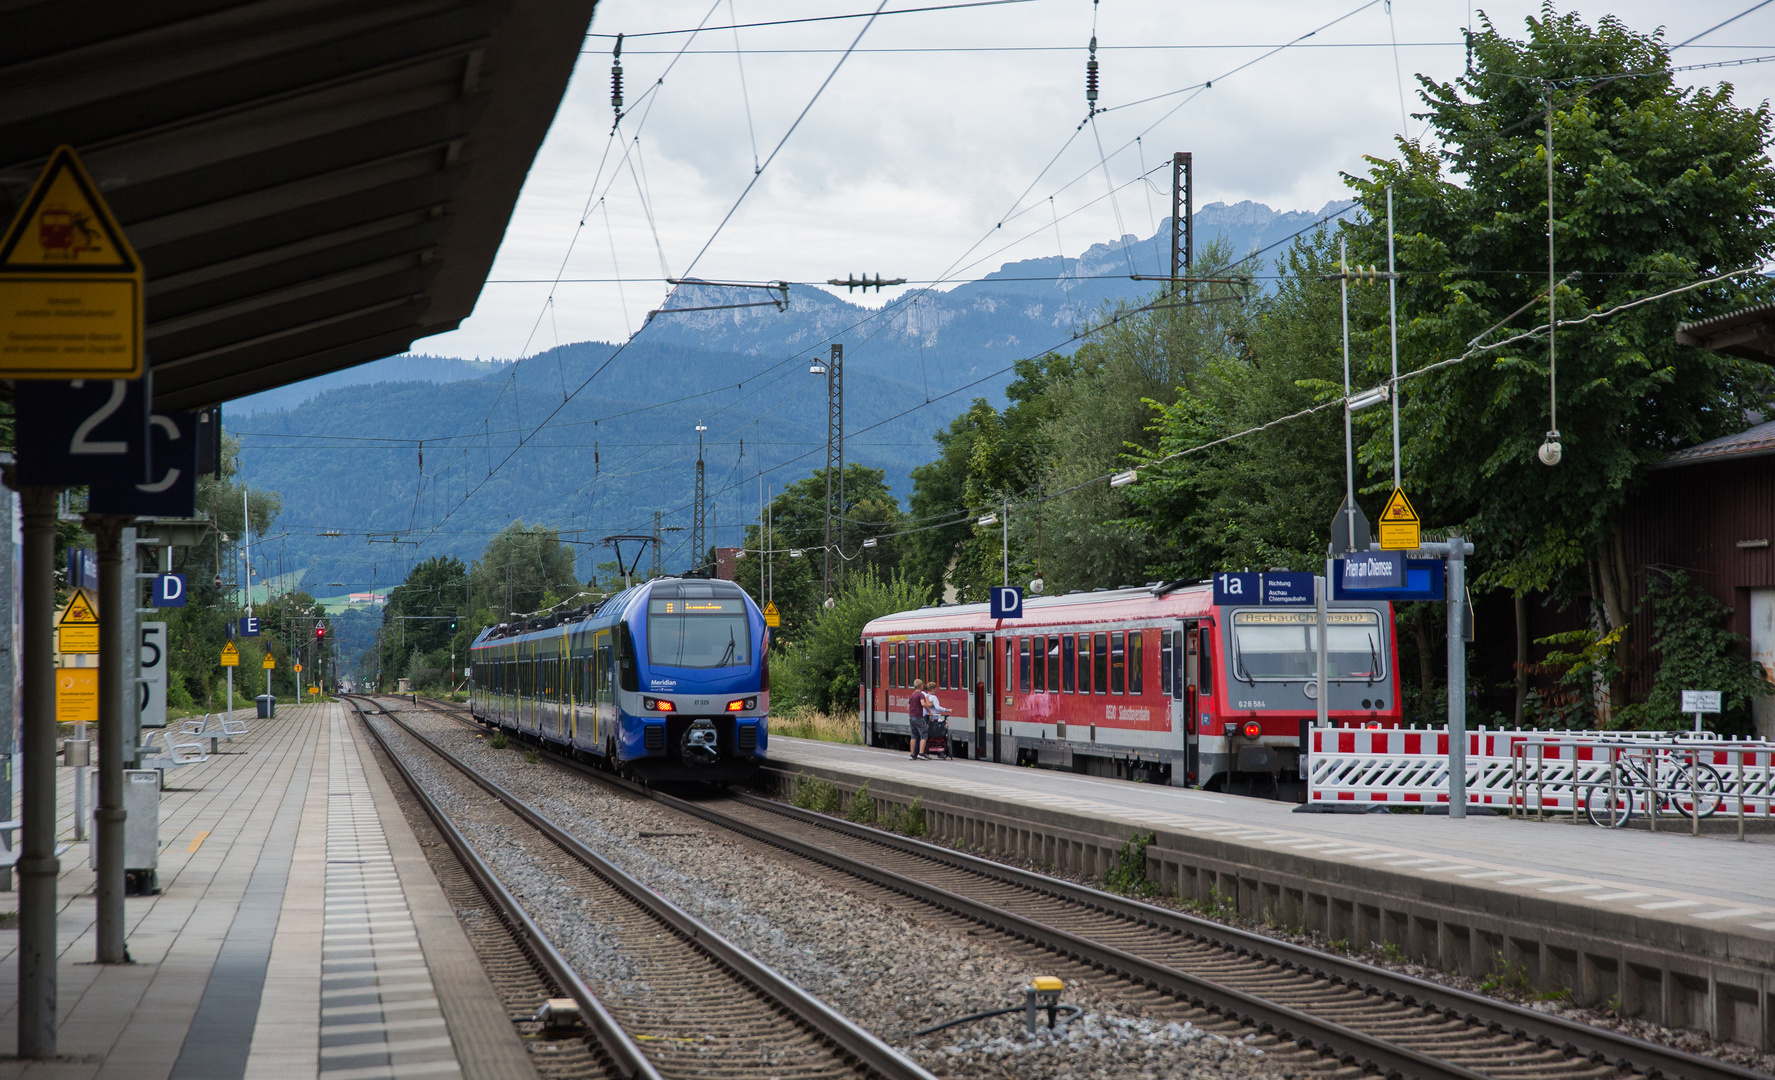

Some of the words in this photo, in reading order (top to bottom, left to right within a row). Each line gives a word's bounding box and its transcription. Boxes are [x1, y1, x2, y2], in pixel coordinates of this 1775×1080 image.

[70, 379, 128, 455] 2
[1345, 558, 1359, 577] Prien
[1359, 562, 1367, 577] am
[1367, 557, 1393, 577] Chiemsee
[163, 574, 182, 600] D
[1218, 574, 1243, 594] 1a
[1268, 580, 1292, 588] Richtung
[1000, 587, 1019, 612] D
[247, 617, 259, 632] E
[1238, 700, 1252, 708] 628
[1253, 700, 1266, 708] 584
